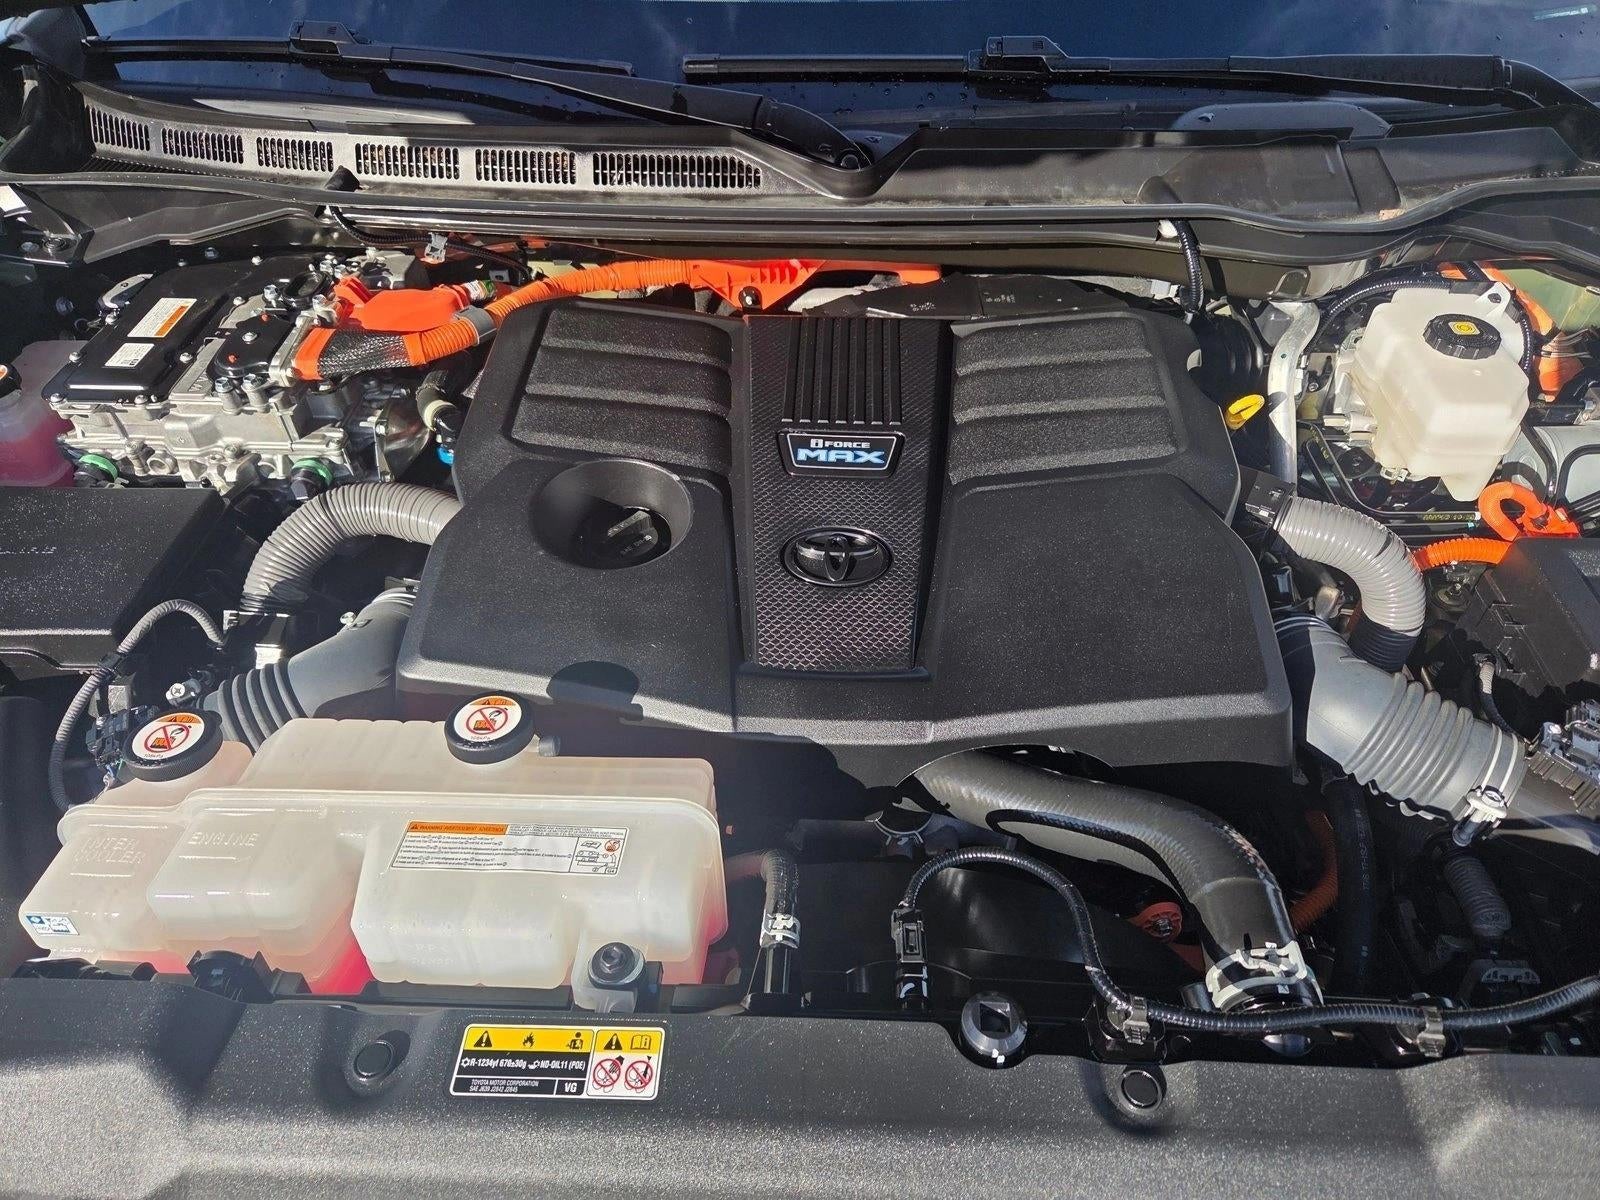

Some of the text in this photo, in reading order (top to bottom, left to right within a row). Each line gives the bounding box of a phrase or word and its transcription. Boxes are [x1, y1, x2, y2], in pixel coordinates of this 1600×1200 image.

[797, 448, 885, 463] MAX
[188, 831, 259, 847] ENGINE
[470, 1058, 499, 1068] R-1234yf
[568, 1060, 586, 1071] (POE)
[564, 1082, 577, 1093] VG
